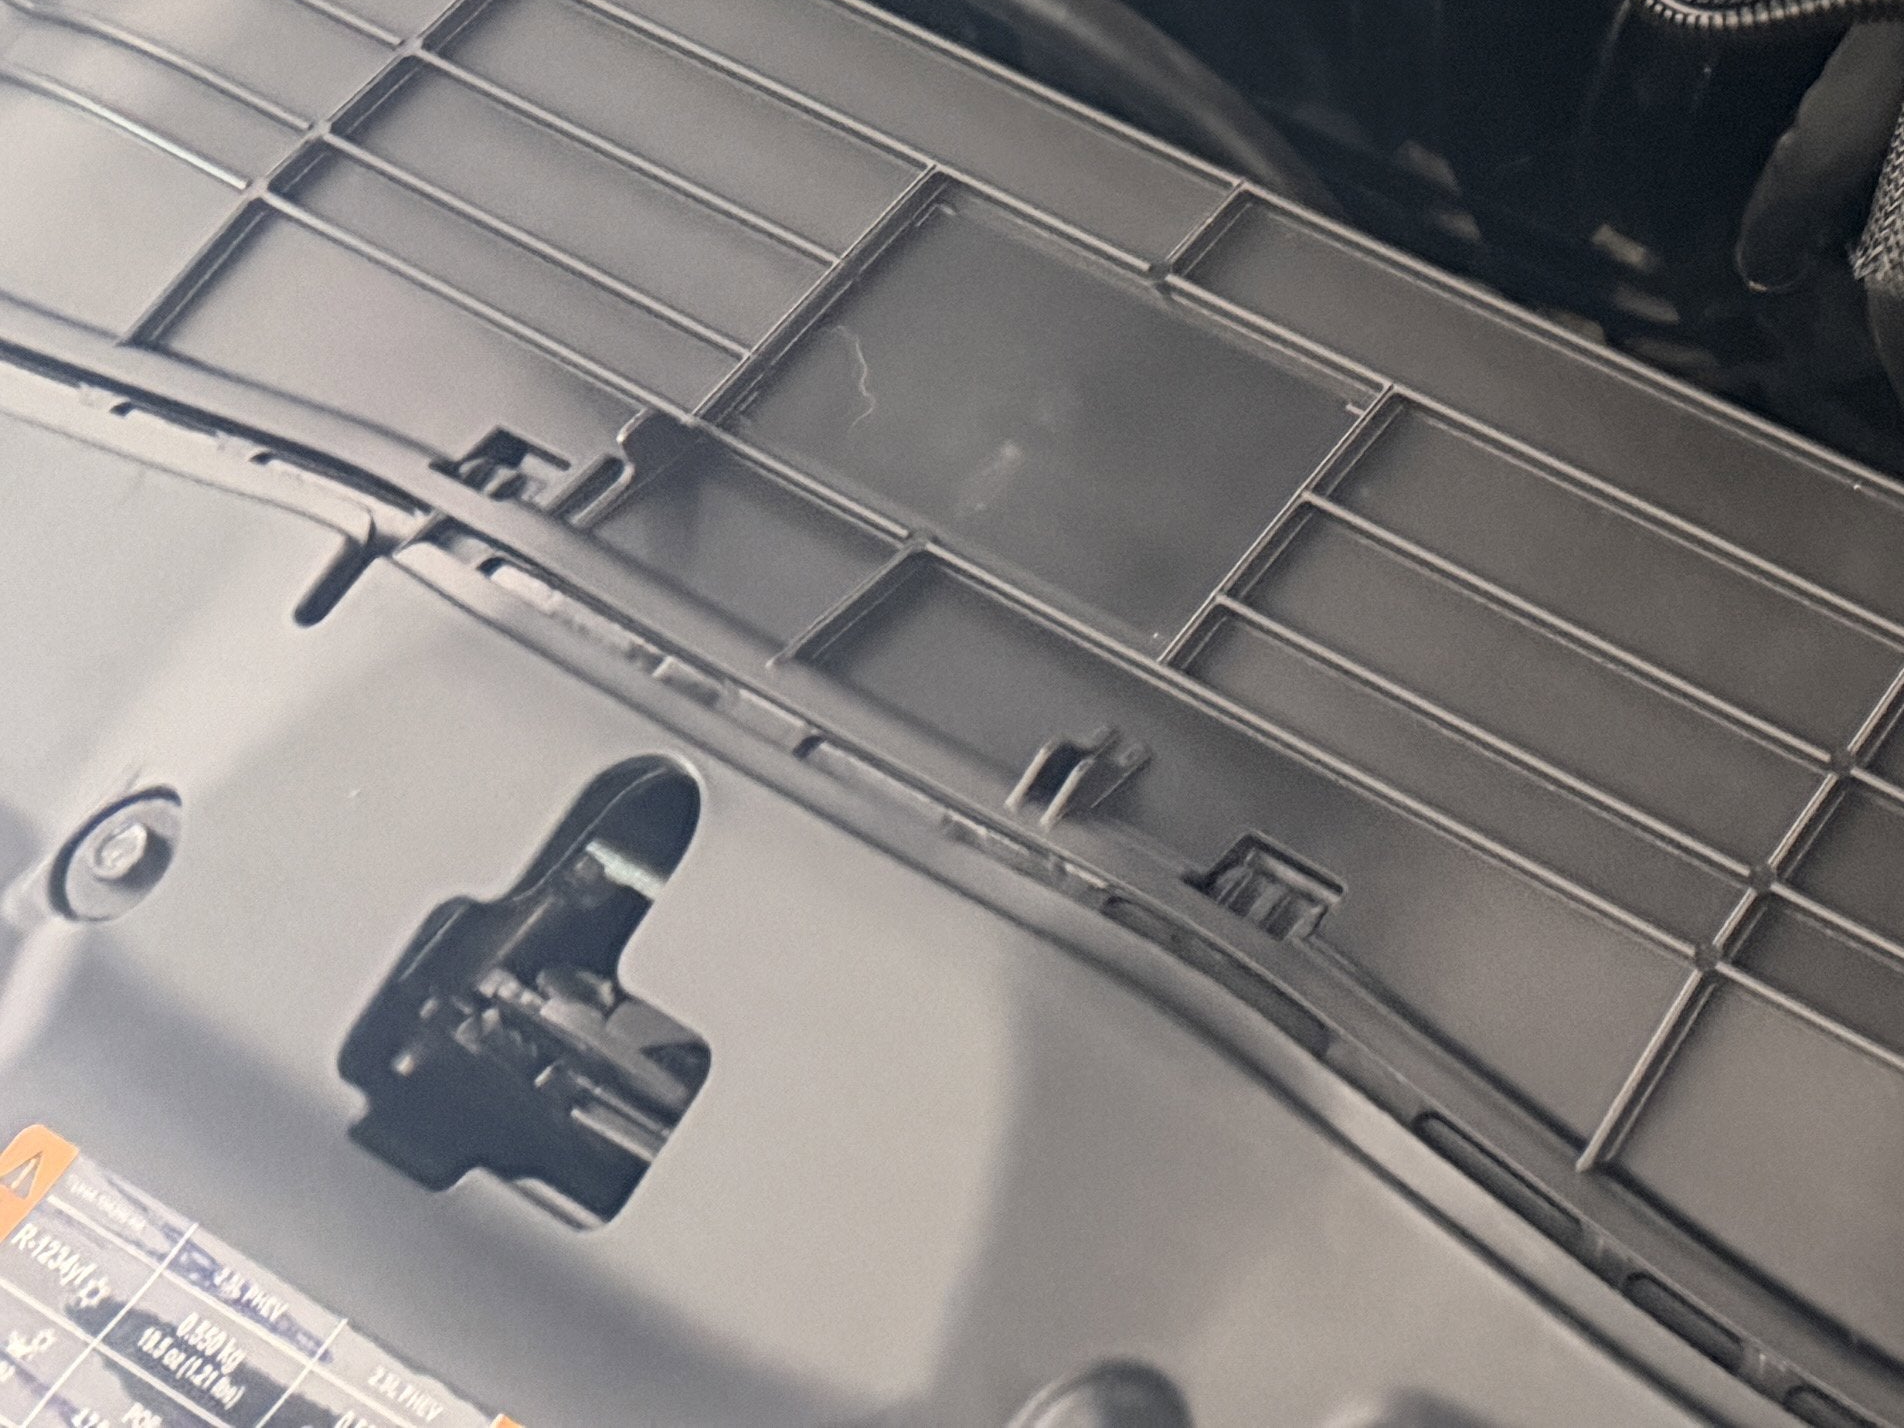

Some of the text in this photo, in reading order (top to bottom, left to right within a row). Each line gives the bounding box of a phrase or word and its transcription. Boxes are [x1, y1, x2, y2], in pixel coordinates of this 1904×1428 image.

[11, 1223, 91, 1286] R-1234yf
[176, 1312, 248, 1373] 0.550 kg
